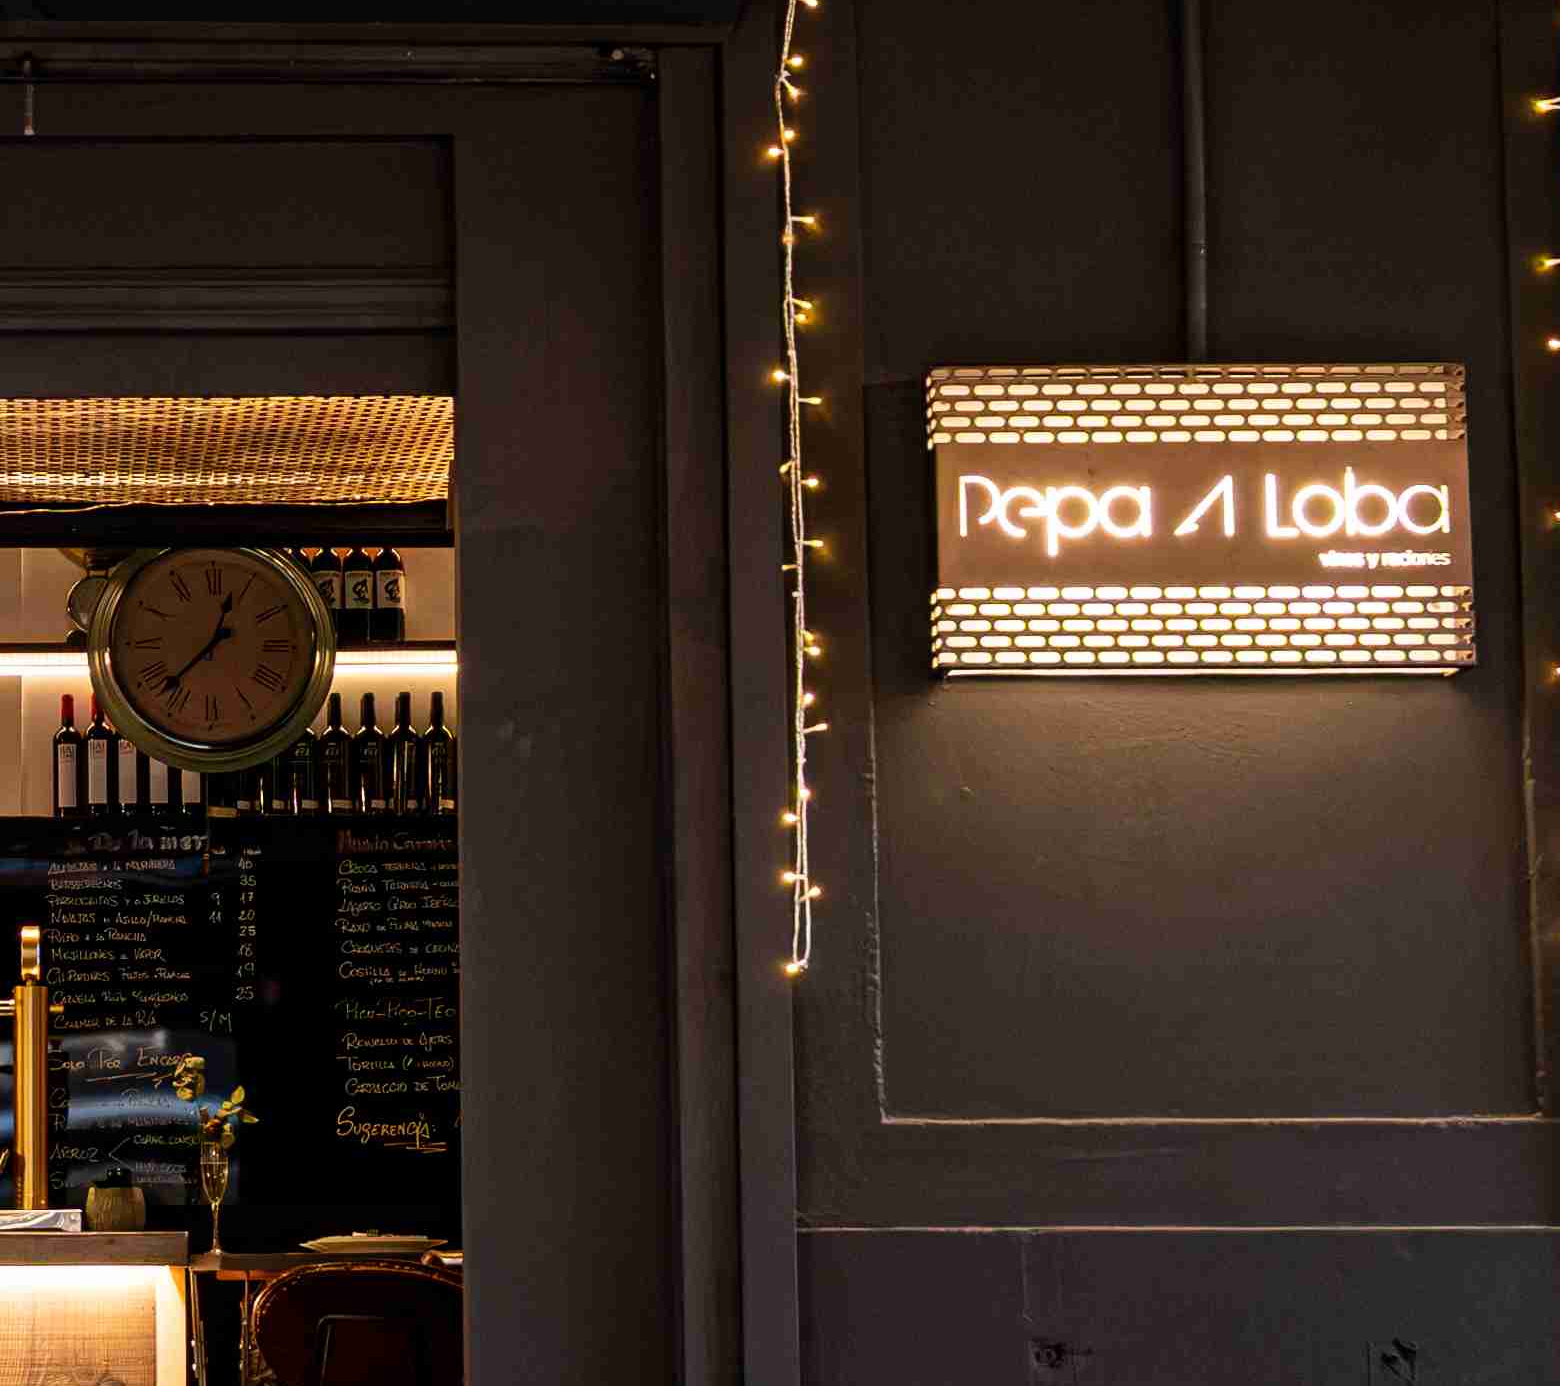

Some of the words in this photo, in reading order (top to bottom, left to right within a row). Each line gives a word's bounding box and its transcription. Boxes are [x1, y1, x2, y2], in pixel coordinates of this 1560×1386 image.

[958, 474, 1153, 557] Pepa
[1172, 474, 1236, 539] A
[1264, 466, 1452, 538] Loba
[240, 874, 256, 886] 35
[240, 892, 255, 905] 17
[239, 925, 256, 937] 25
